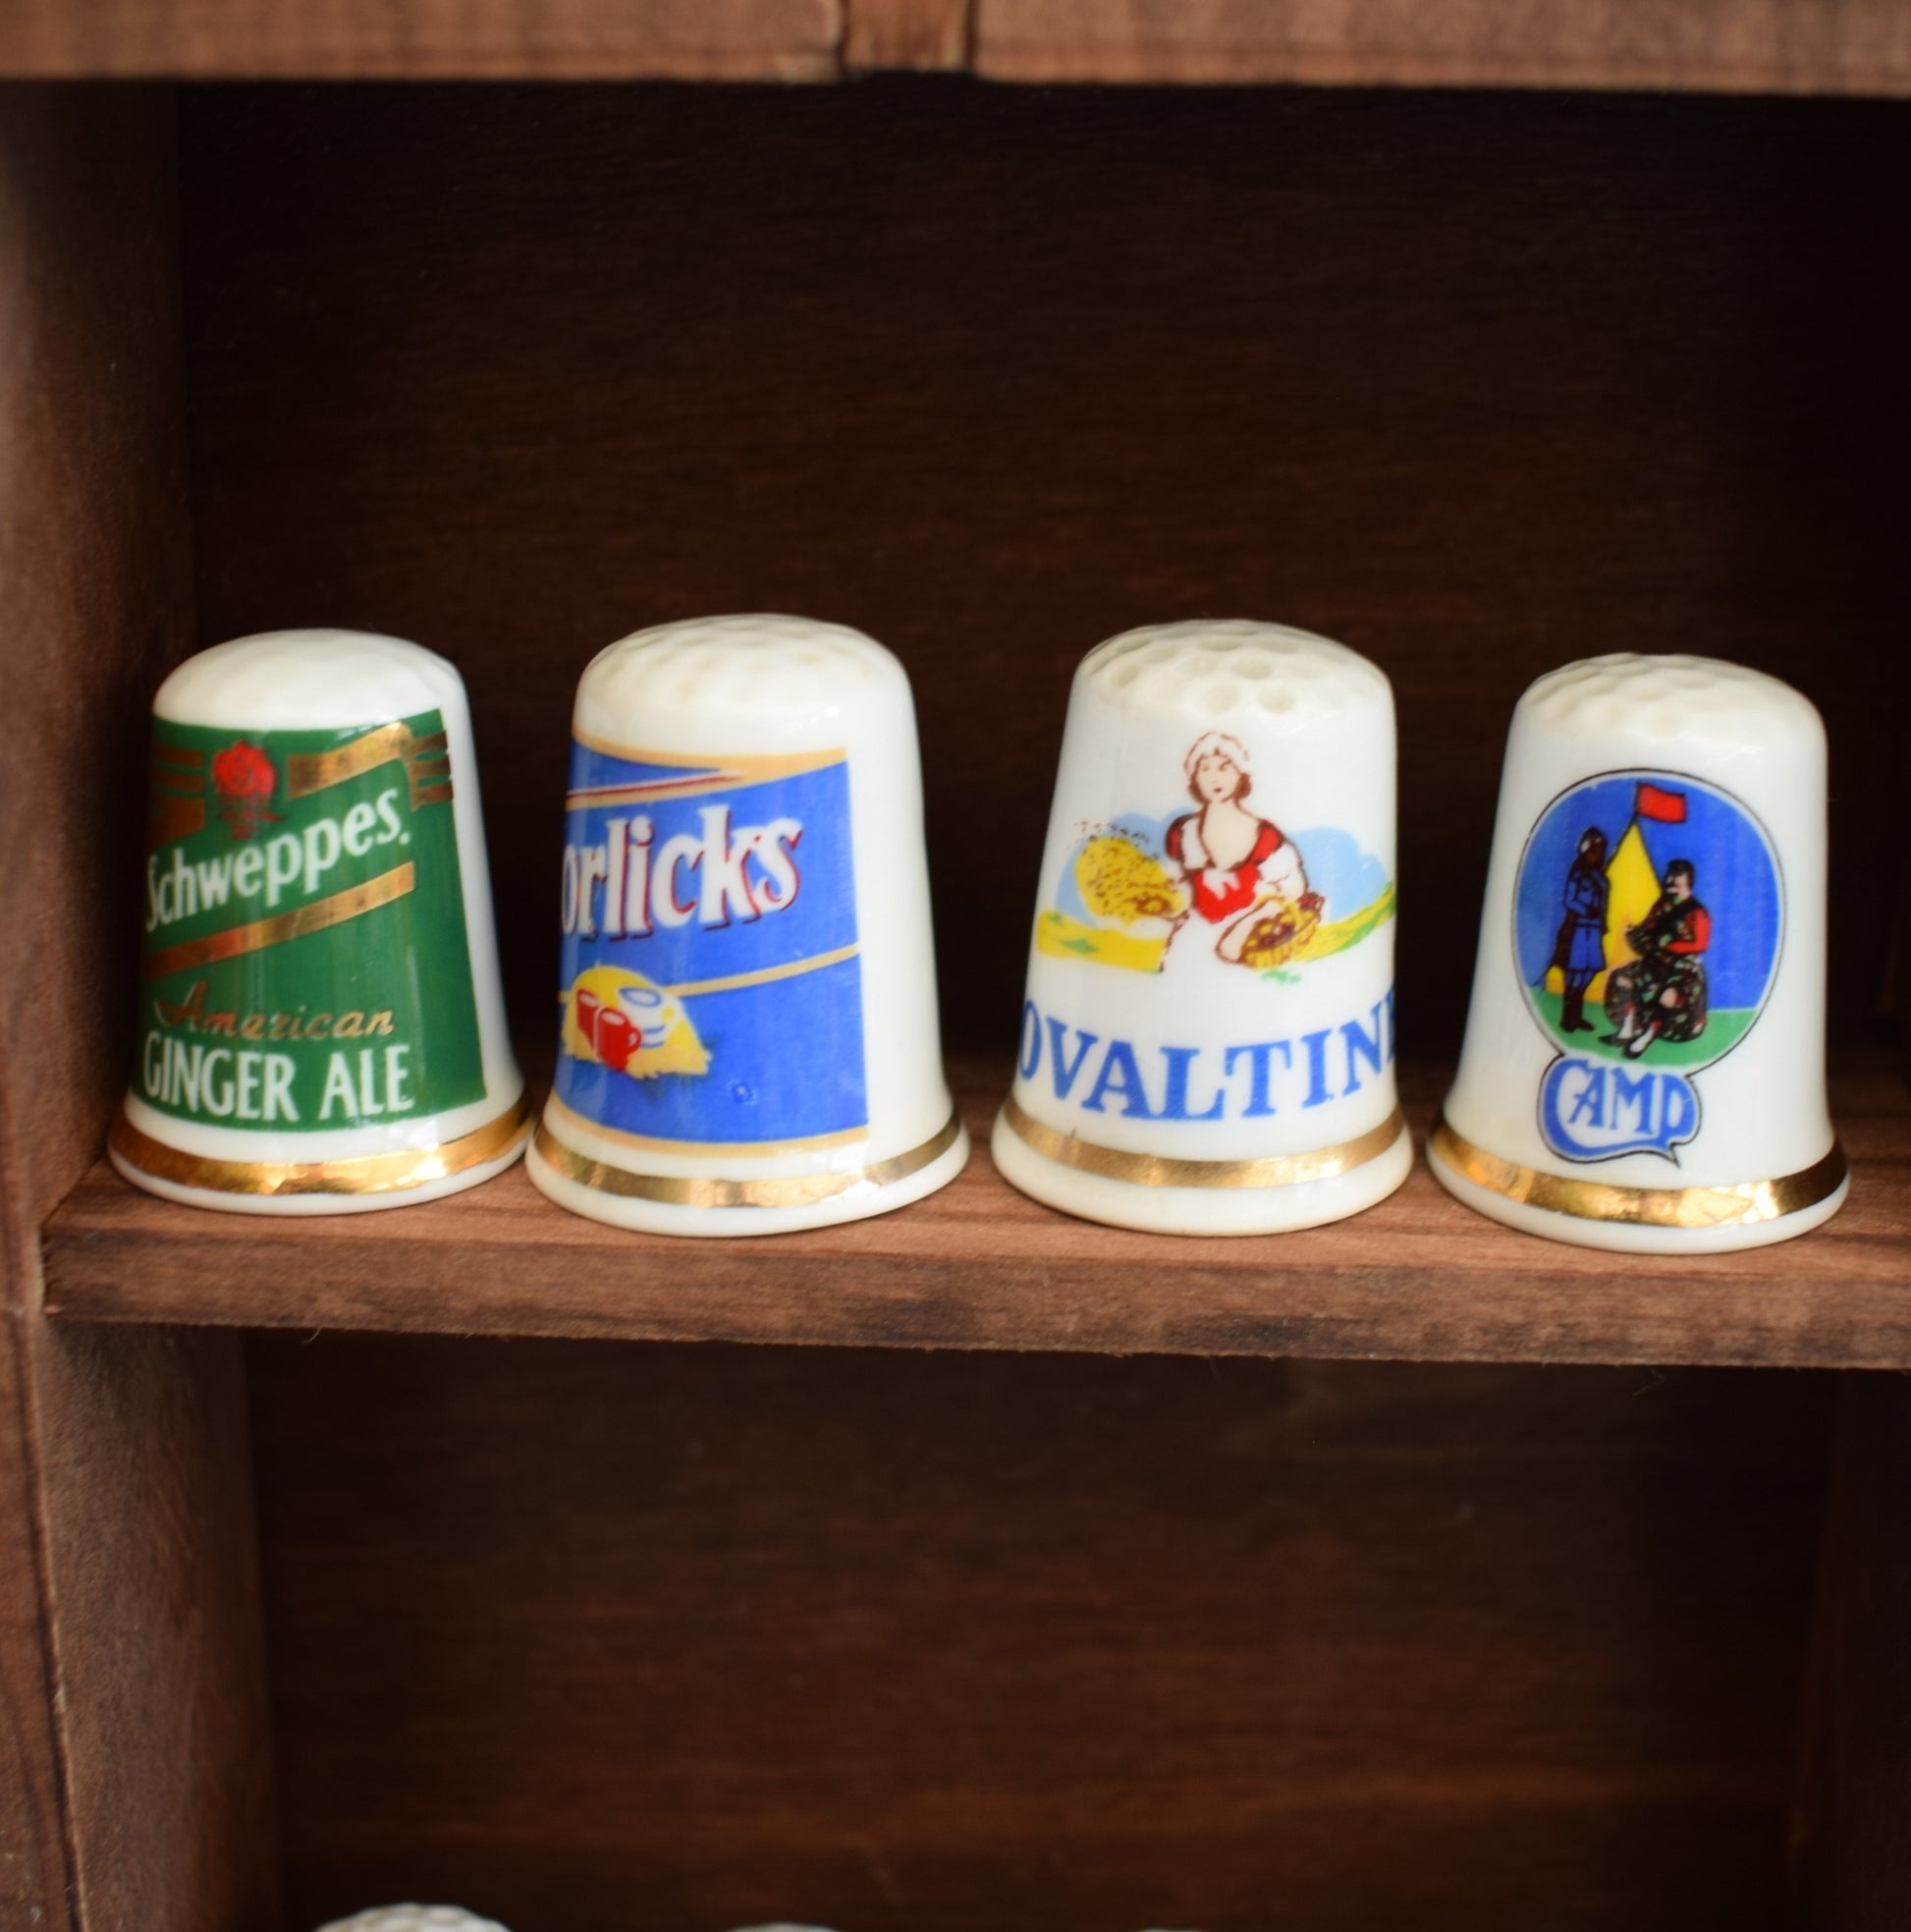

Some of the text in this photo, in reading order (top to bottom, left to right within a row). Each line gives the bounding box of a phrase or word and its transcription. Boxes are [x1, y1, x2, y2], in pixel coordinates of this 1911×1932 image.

[154, 980, 394, 1041] American
[143, 1029, 414, 1122] GINGER ALE
[1543, 1058, 1697, 1158] CAMP
